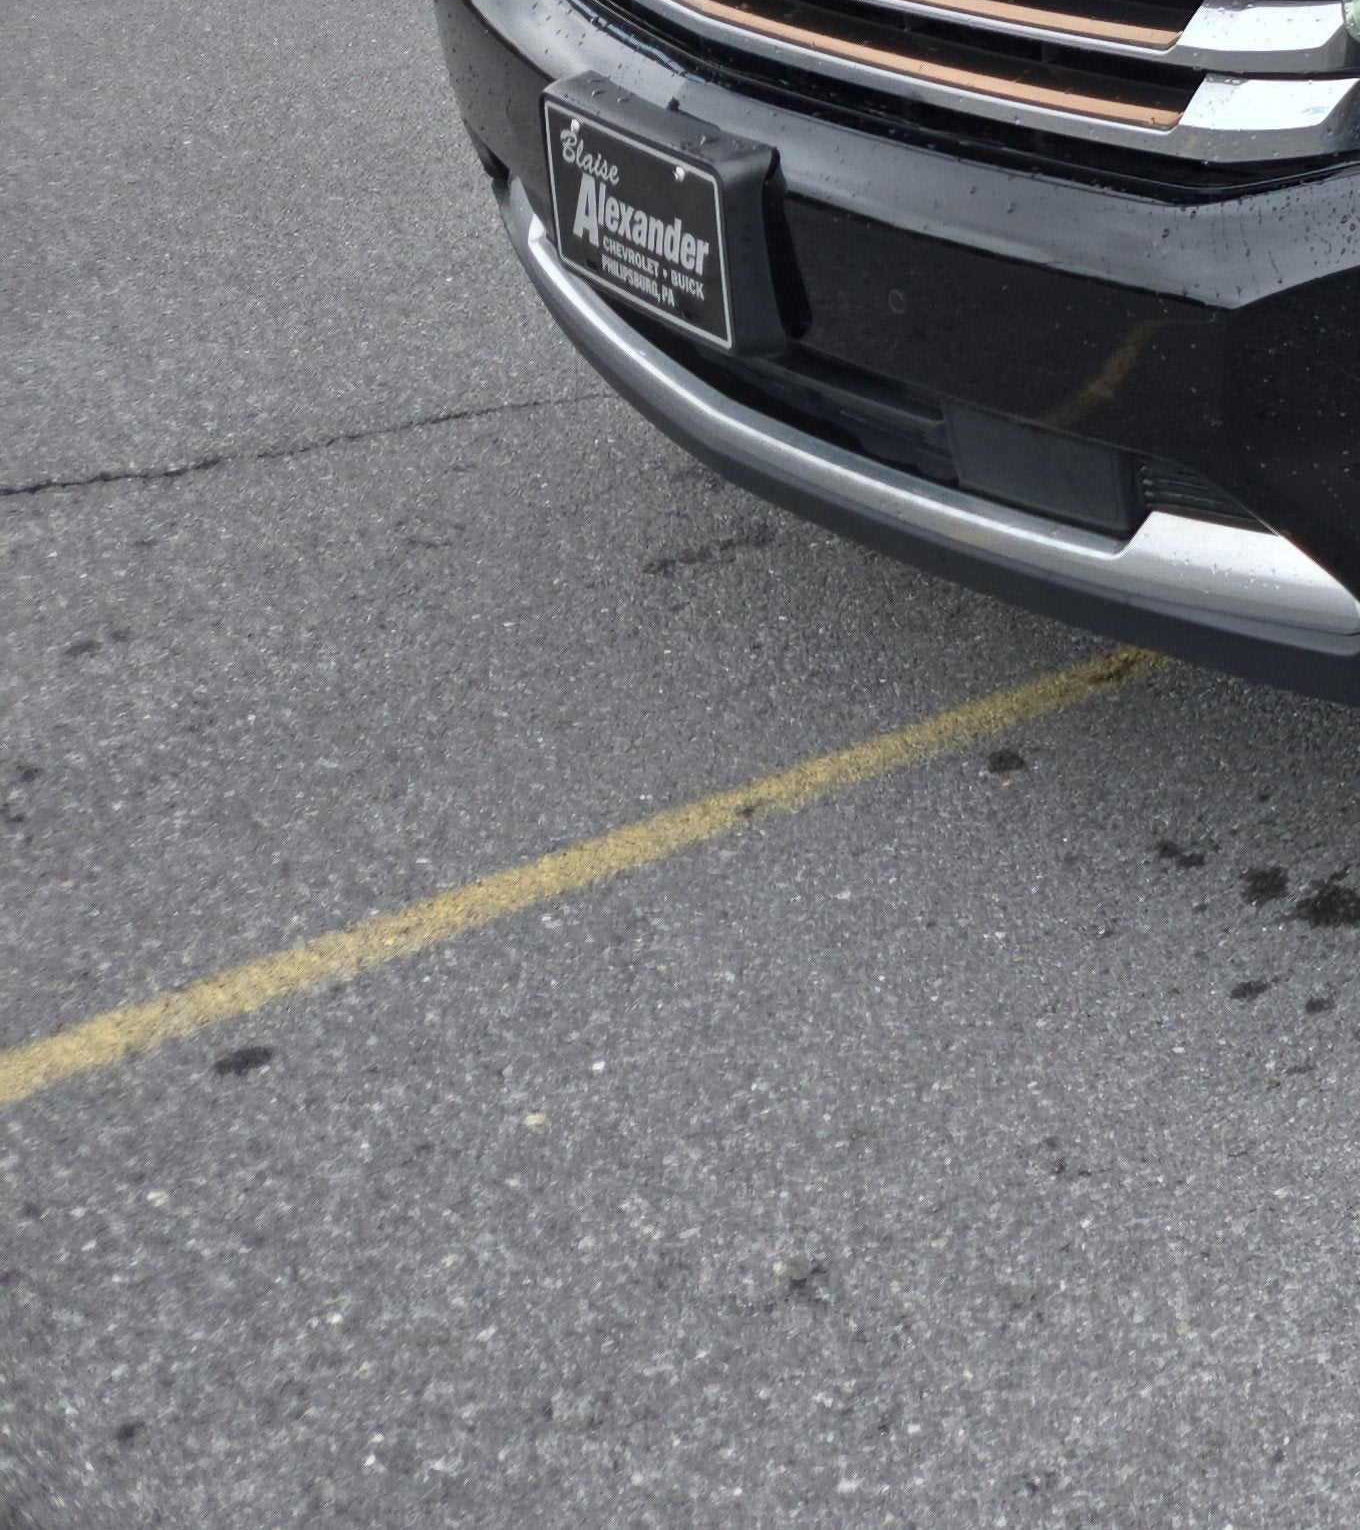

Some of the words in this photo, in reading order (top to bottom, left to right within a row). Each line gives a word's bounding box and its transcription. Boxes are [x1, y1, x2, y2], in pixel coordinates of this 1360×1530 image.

[560, 129, 620, 186] Blaise
[573, 173, 710, 276] Alexander
[603, 235, 660, 278] CHEVROLET
[671, 271, 705, 301] BUICK
[661, 287, 676, 308] PA
